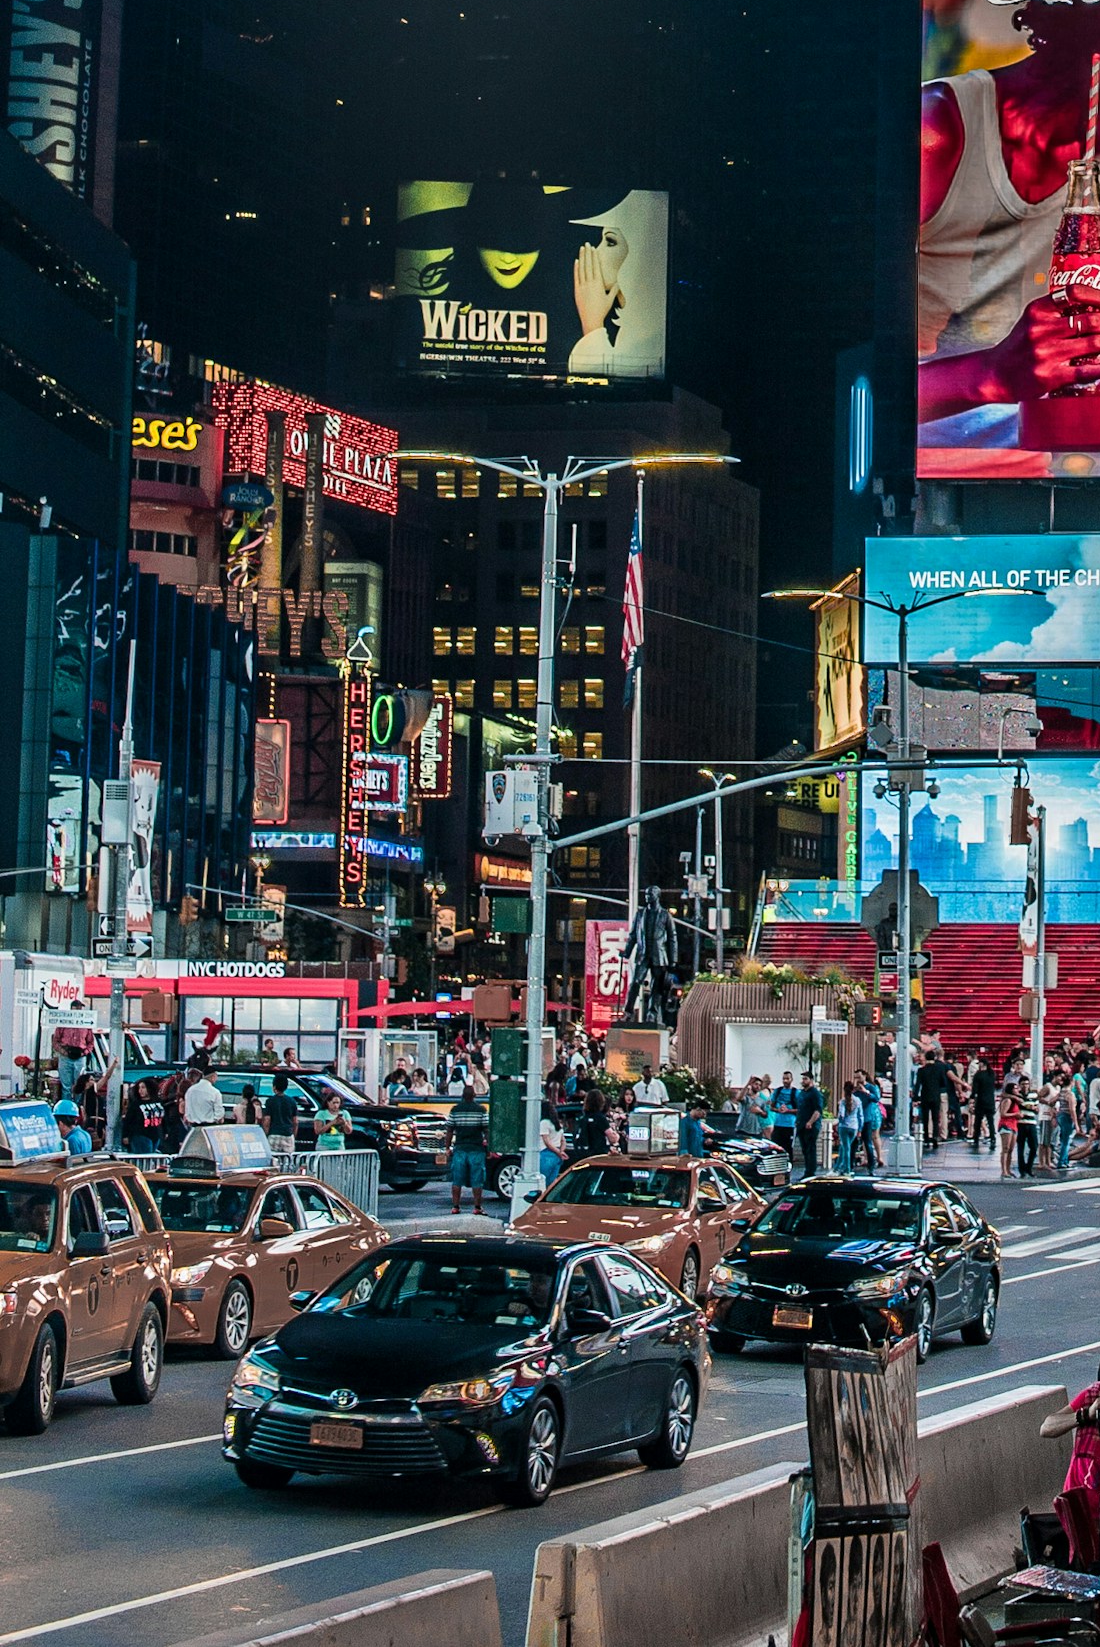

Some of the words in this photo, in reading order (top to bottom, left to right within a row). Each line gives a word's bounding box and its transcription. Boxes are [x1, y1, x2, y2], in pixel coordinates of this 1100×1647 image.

[909, 570, 965, 589] WHEN
[968, 570, 1003, 588] ALL
[1007, 569, 1031, 587] OF
[1034, 569, 1071, 587] THE
[419, 703, 443, 790] Twizzlers
[189, 962, 215, 977] NYC
[216, 961, 285, 977] HOTDOGS
[51, 978, 80, 1003] Ryder
